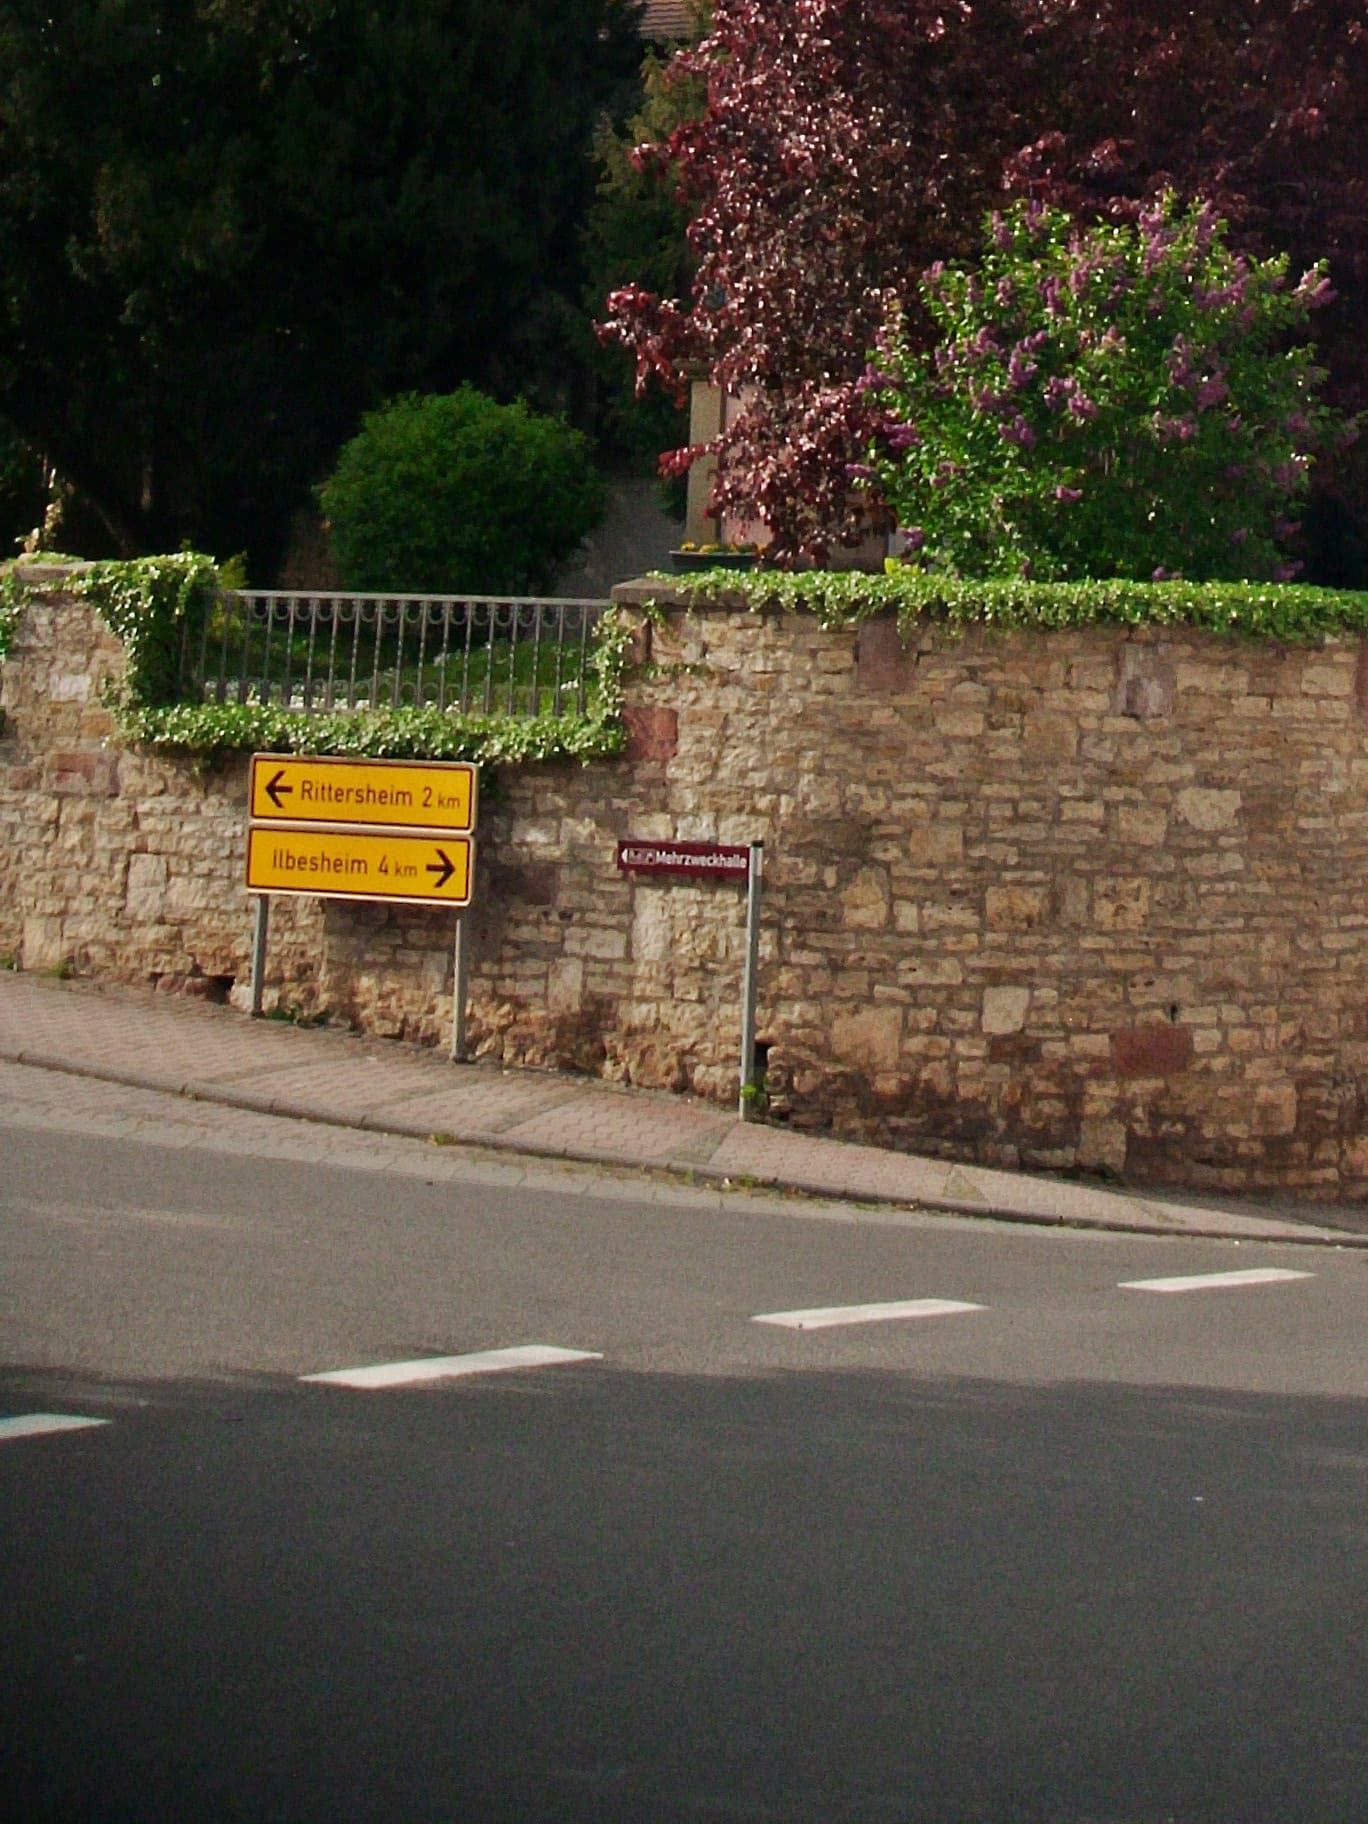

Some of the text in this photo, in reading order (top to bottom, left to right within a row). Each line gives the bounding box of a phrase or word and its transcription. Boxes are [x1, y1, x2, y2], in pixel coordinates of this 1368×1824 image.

[301, 779, 461, 810] Rittersheim 2 km
[272, 848, 418, 878] Ilbesheim 4 km
[656, 850, 748, 870] Mehrzweckhalle
